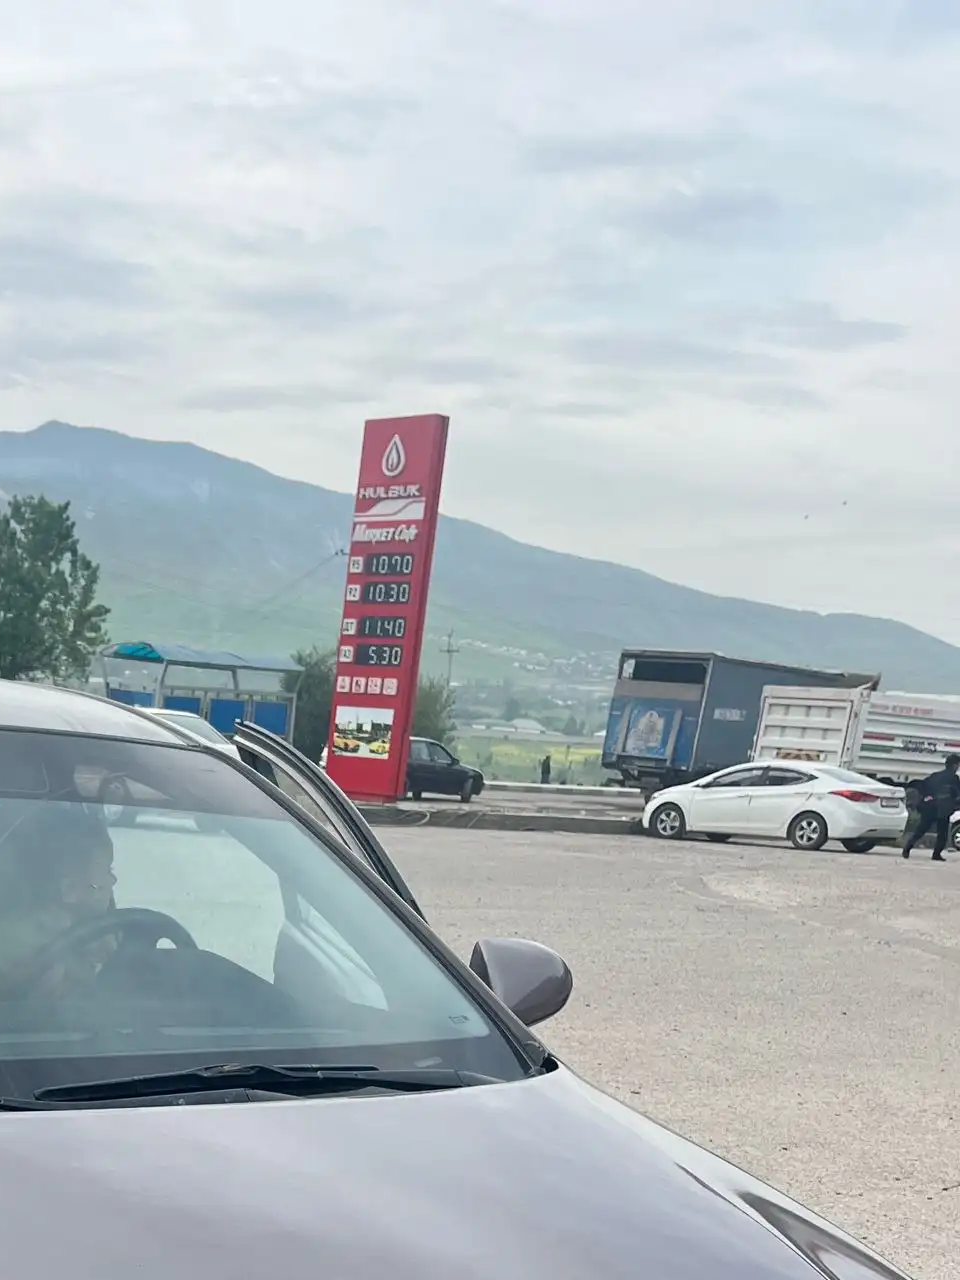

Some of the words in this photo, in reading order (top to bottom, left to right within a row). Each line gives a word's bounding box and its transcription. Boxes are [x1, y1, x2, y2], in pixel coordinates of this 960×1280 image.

[359, 484, 420, 500] HULBUK
[365, 619, 405, 636] 11.40
[369, 646, 401, 665] 5.30
